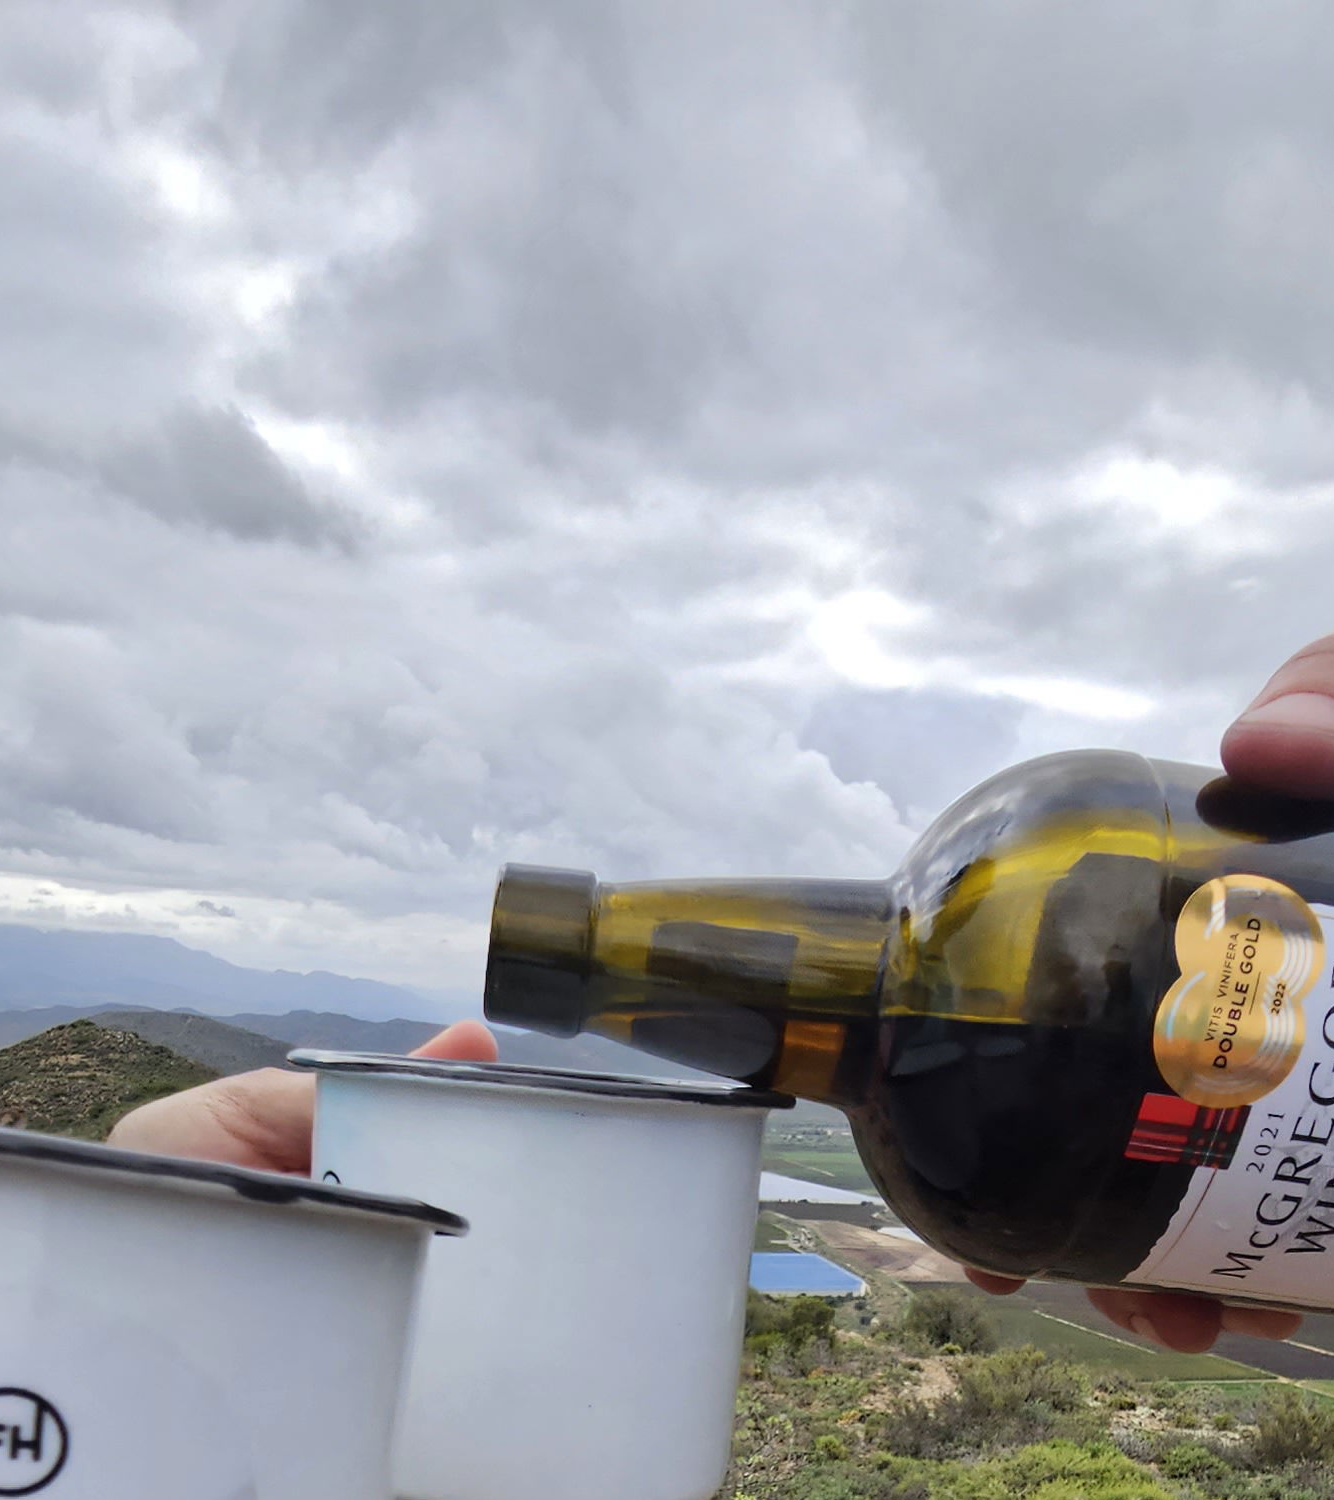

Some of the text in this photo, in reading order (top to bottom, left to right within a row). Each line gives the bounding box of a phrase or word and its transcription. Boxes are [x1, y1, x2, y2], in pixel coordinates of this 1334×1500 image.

[1204, 932, 1240, 1042] VITIS VINIFERA
[1212, 917, 1262, 1069] DOUBLE GOLD
[1270, 982, 1287, 1015] 2022
[1245, 1110, 1285, 1174] 2021
